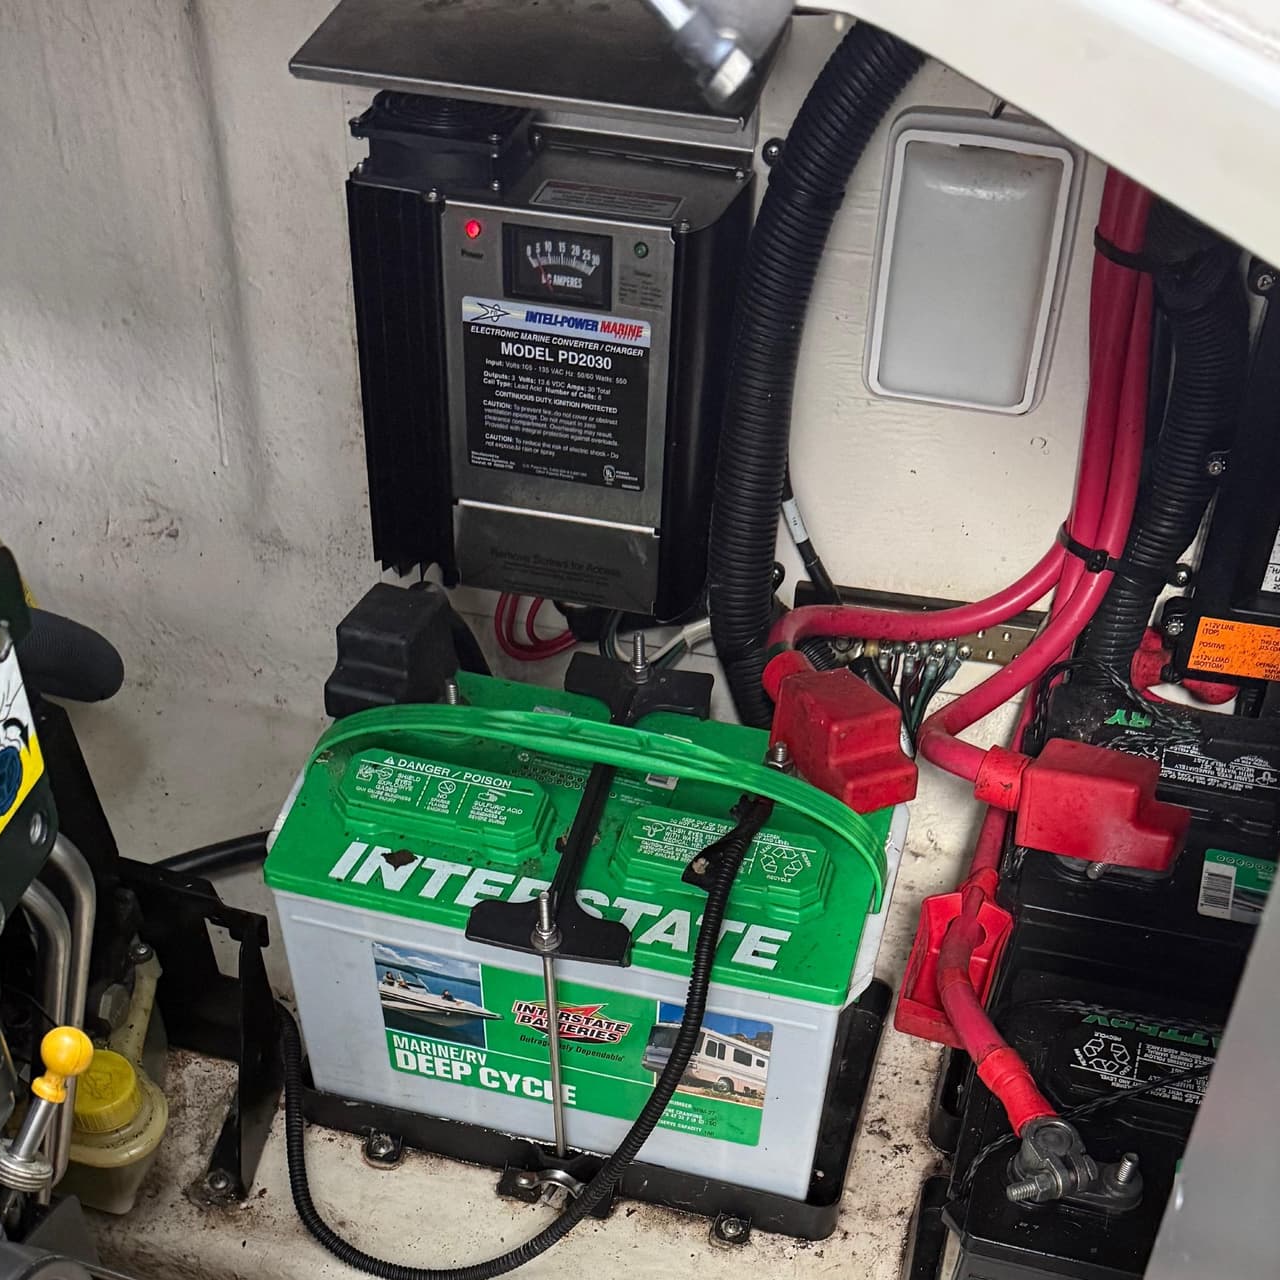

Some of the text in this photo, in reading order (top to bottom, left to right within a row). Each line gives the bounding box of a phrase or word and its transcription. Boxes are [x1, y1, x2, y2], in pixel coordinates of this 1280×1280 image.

[526, 241, 600, 265] 0 5 10 15 20 25 30
[553, 274, 582, 289] AMPERES
[525, 310, 644, 337] INTELI-POWER MARINE
[470, 325, 519, 339] ELECTRONIC
[520, 332, 551, 344] MARINE
[551, 336, 599, 351] CONVERTER
[605, 344, 644, 357] CHARGER
[501, 342, 612, 370] MODEL PD2030
[485, 358, 505, 368] Input:
[550, 367, 564, 376] VAC
[483, 371, 511, 382] Outputs:
[519, 375, 537, 385] Volts:
[551, 379, 565, 389] VDC
[566, 382, 587, 393] Amps:
[597, 386, 611, 395] Total
[483, 378, 497, 387] Cell
[497, 380, 514, 391] Type:
[514, 383, 529, 391] Lead
[529, 385, 542, 393] Acid
[545, 387, 569, 397] Number
[578, 391, 597, 400] Cells:
[483, 400, 512, 410] CAUTION:
[494, 389, 535, 402] CONTINUOUS
[553, 397, 581, 409] IGNITION
[581, 401, 617, 414] PROTECTED
[1202, 628, 1220, 636] (TOP)
[1199, 641, 1225, 650] POSITIVE
[397, 773, 421, 782] SHIELD
[398, 758, 450, 777] DANGER
[463, 772, 512, 788] POISON
[375, 785, 398, 794] GASES
[473, 800, 523, 815] SULFURIC ACID
[664, 832, 681, 840] WITH
[666, 826, 704, 838] FLUSH EYES
[663, 836, 688, 846] MEDICAL
[766, 874, 792, 883] RECYCLE
[516, 1003, 628, 1033] INTRSTATE
[1094, 1032, 1122, 1041] RECYCLE
[392, 1034, 487, 1066] MARINE/RV
[576, 1046, 624, 1062] Dependable
[395, 1048, 577, 1106] DEEP CYCLE
[1099, 1074, 1117, 1082] LEVEL
